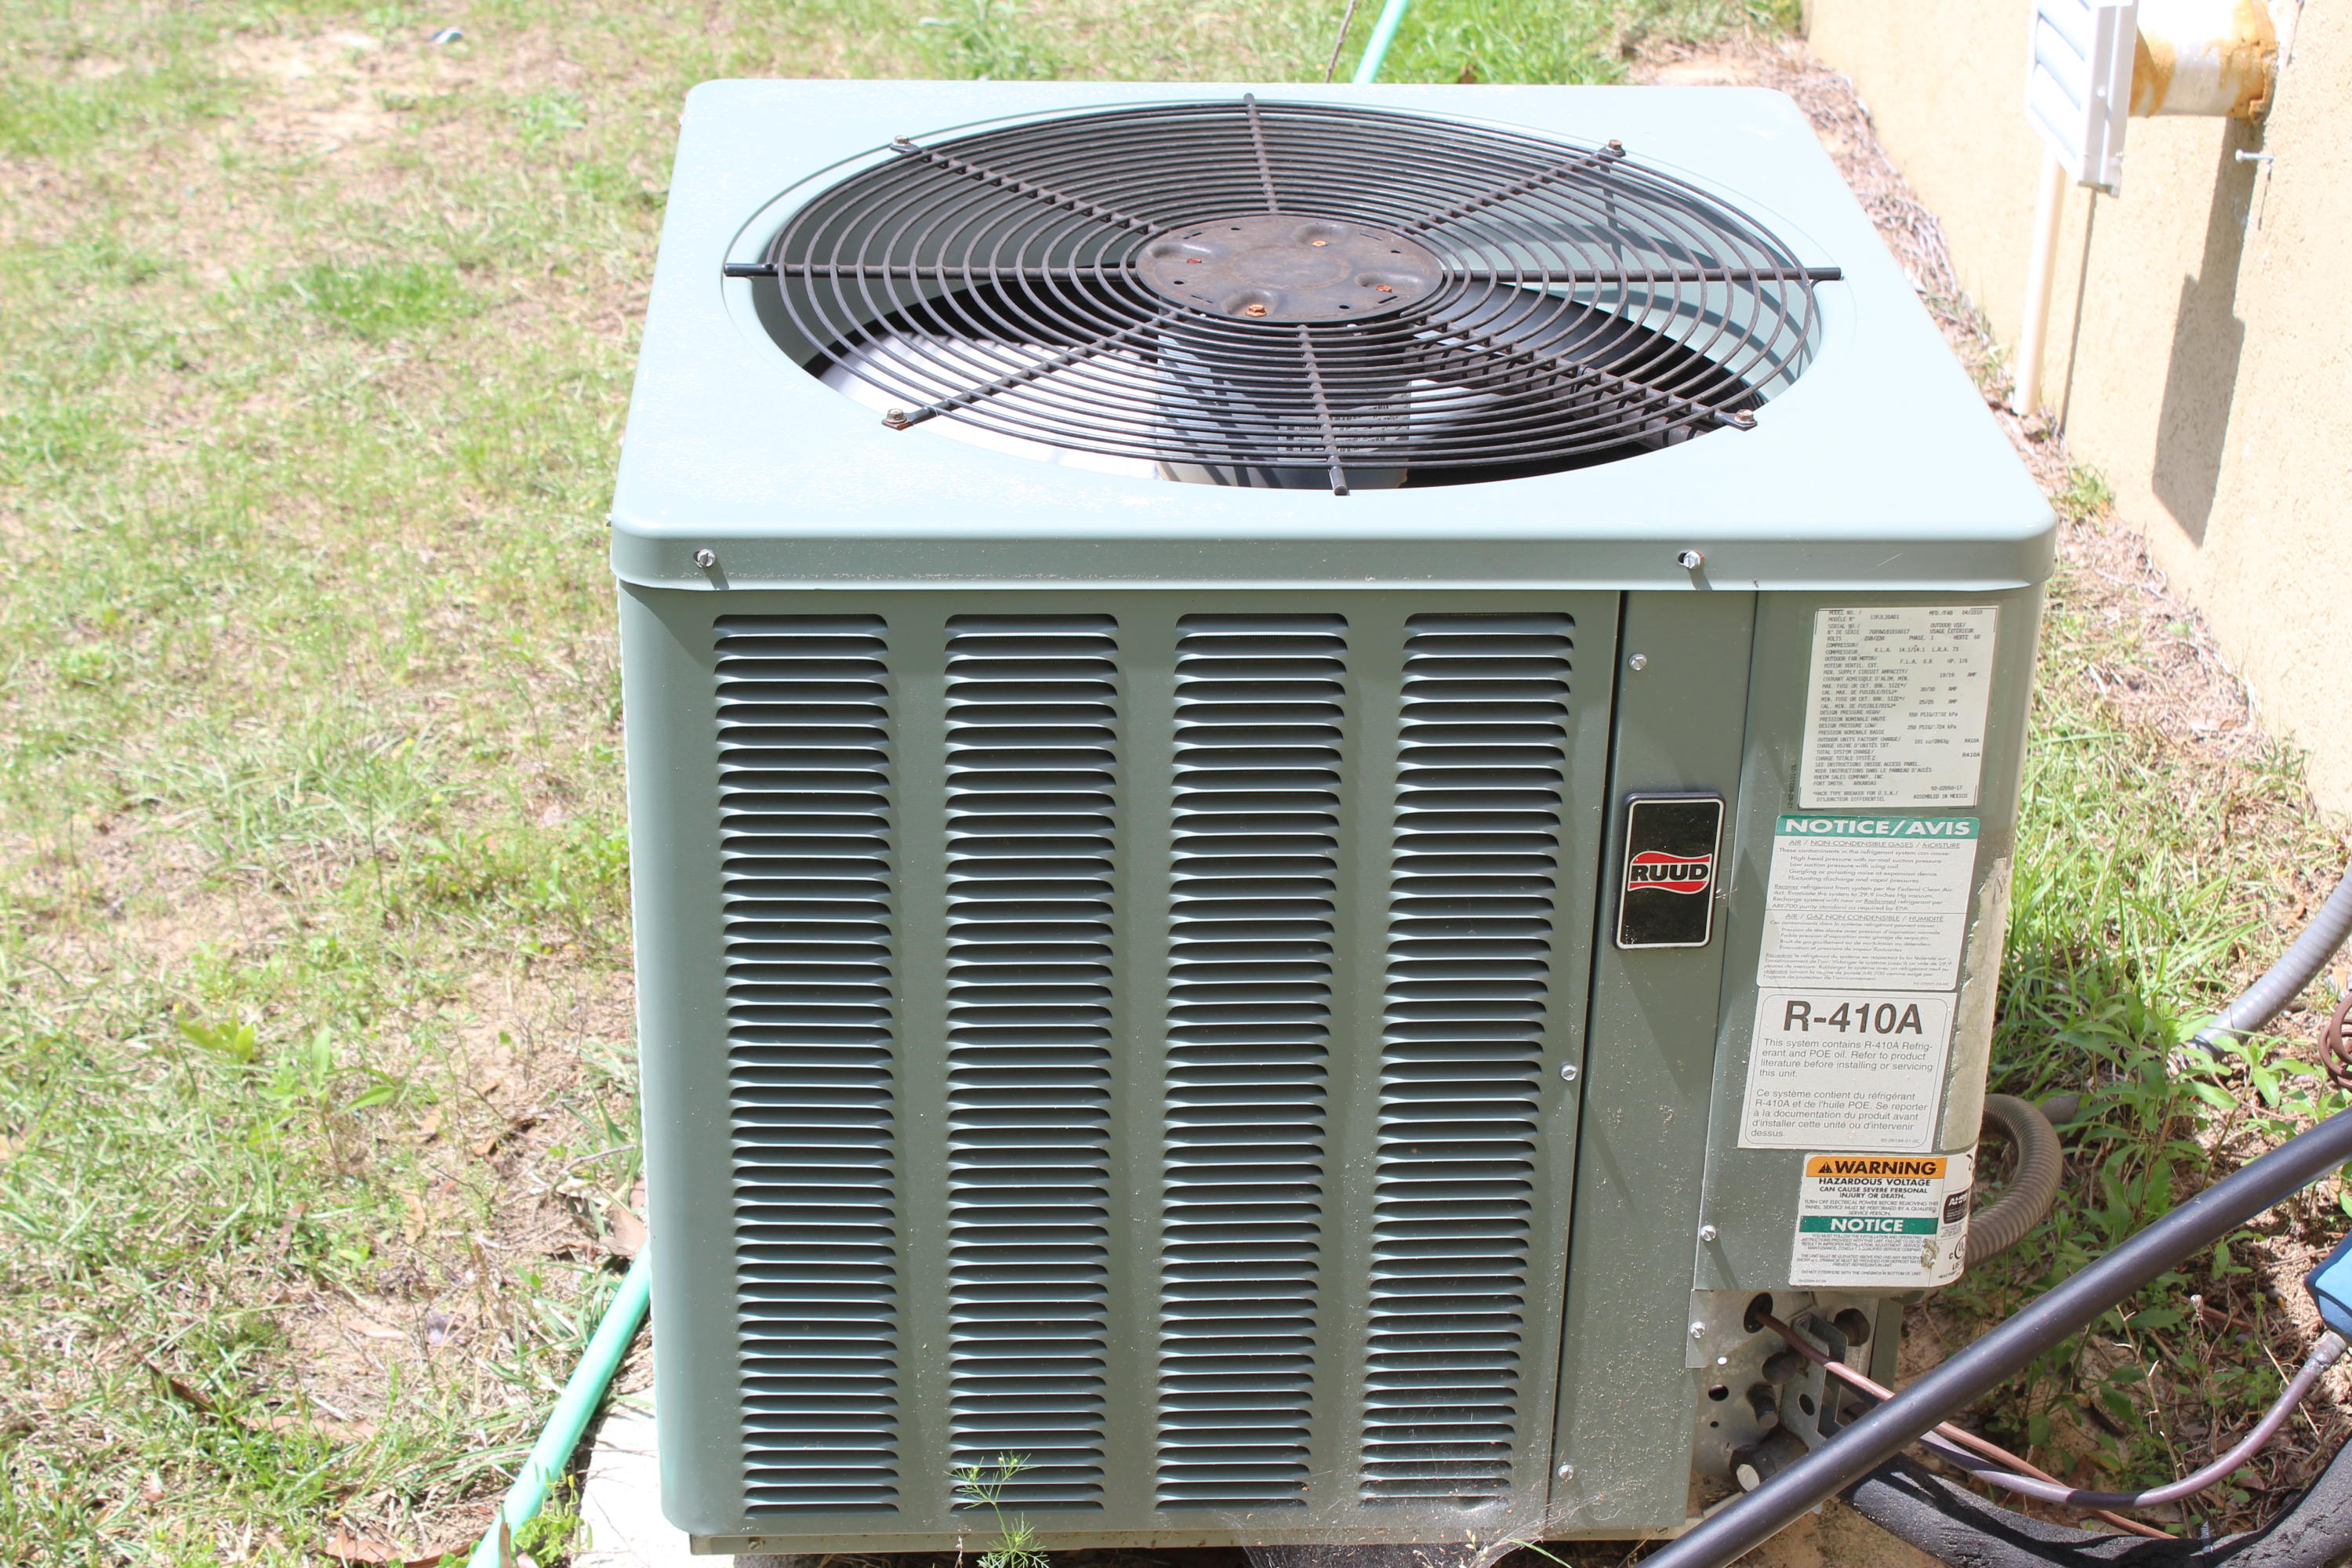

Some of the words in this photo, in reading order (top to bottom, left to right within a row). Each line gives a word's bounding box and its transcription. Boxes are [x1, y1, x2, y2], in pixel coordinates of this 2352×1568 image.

[1785, 819, 1970, 836] NOTICE/AVIS
[1631, 864, 1708, 881] RUUD
[1784, 1000, 1922, 1034] R-410A
[1786, 1040, 1819, 1048] system
[1902, 1042, 1933, 1052] Refrig-
[1850, 1051, 1876, 1059] Refer
[1890, 1052, 1926, 1061] product
[1803, 1060, 1833, 1069] before
[1836, 1061, 1877, 1071] installing
[1892, 1062, 1933, 1073] servicing
[1773, 1090, 1811, 1098] système
[1867, 1091, 1915, 1102] réfrigérant
[1875, 1102, 1889, 1110] Se
[1753, 1109, 1759, 1117] à
[1773, 1110, 1841, 1119] documentation
[1858, 1112, 1890, 1120] produit
[1752, 1119, 1795, 1127] d'installer
[1824, 1120, 1846, 1129] unité
[1864, 1122, 1914, 1131] d'intervenir
[1835, 1160, 1936, 1175] WARNING
[1831, 1218, 1904, 1232] NOTICE
